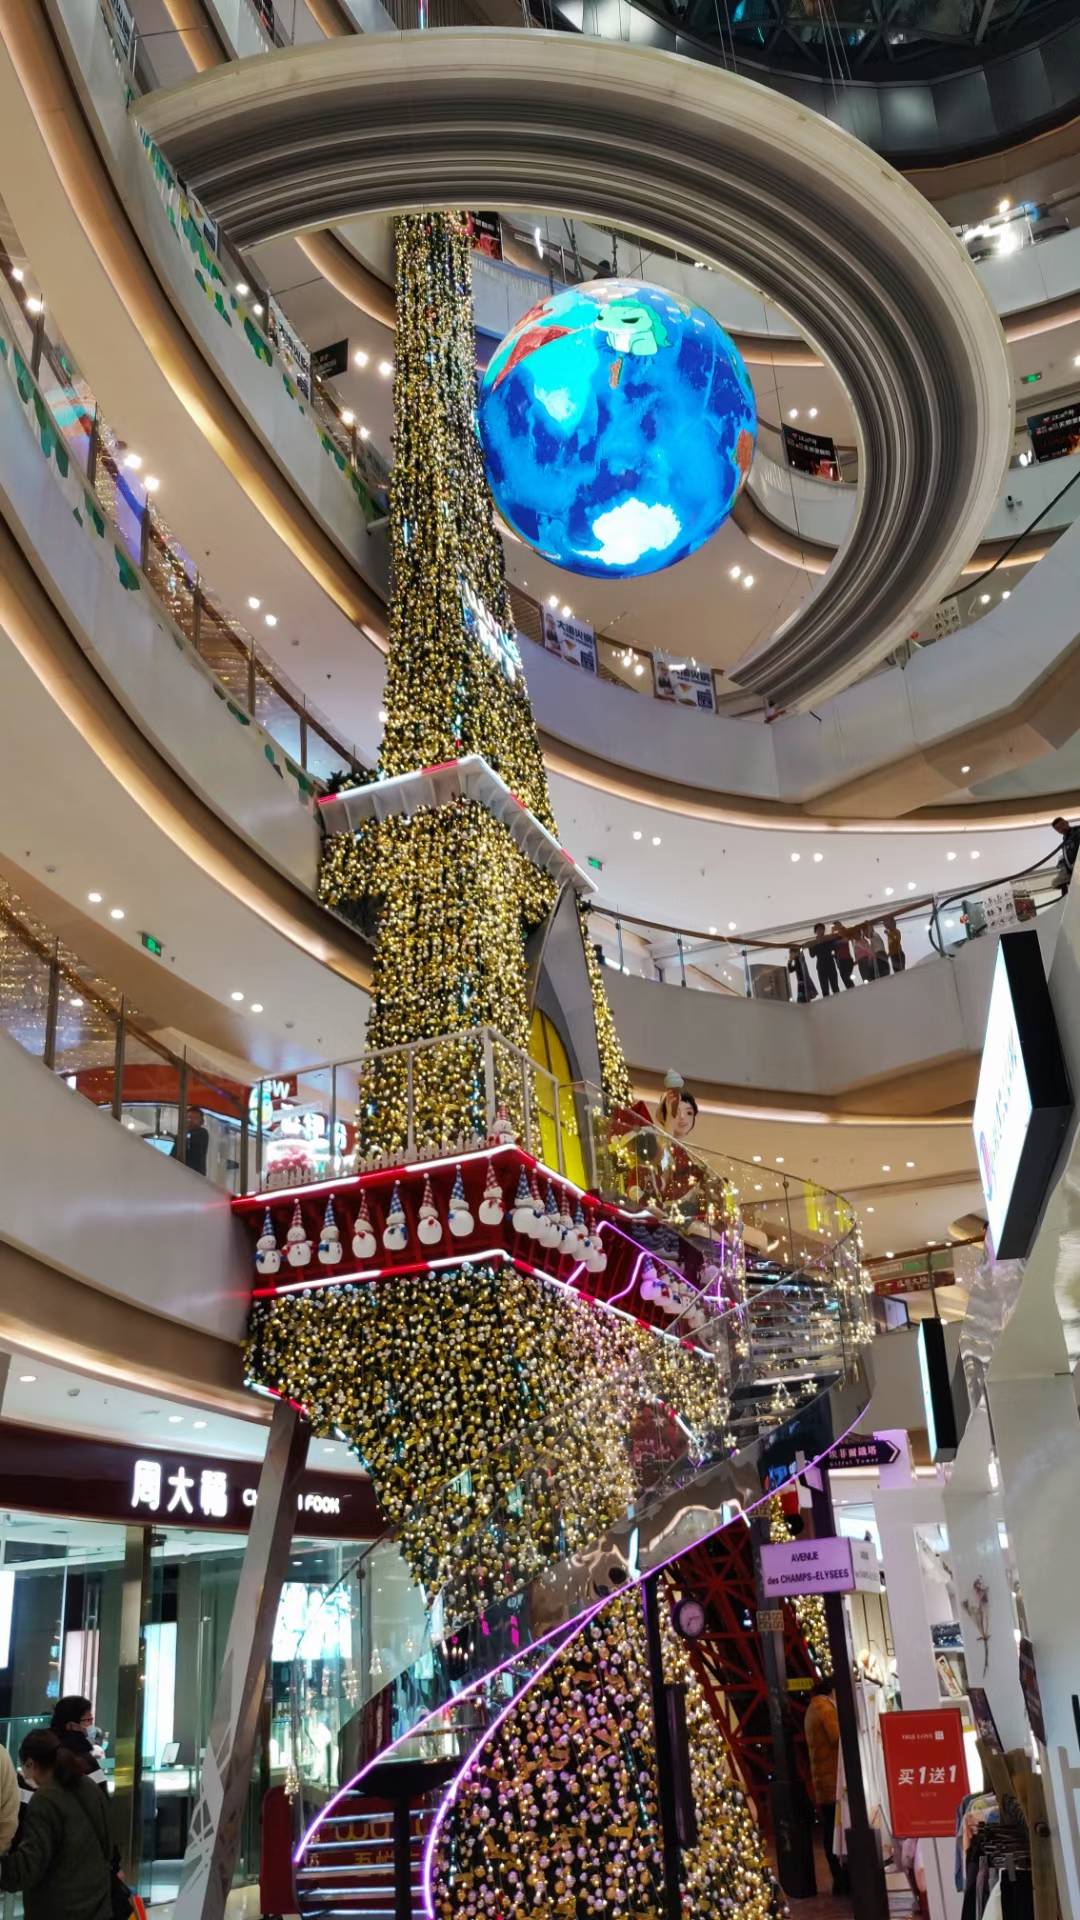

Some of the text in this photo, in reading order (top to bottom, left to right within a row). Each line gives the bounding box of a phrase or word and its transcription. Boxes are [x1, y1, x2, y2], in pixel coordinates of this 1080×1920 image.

[131, 1459, 229, 1518] 周大福
[304, 1494, 340, 1514] FOOK
[791, 1551, 819, 1563] AVENUE
[767, 1576, 779, 1585] des
[780, 1568, 849, 1584] CHAMPS-ELYSEES
[898, 1764, 957, 1785] 买1送1
